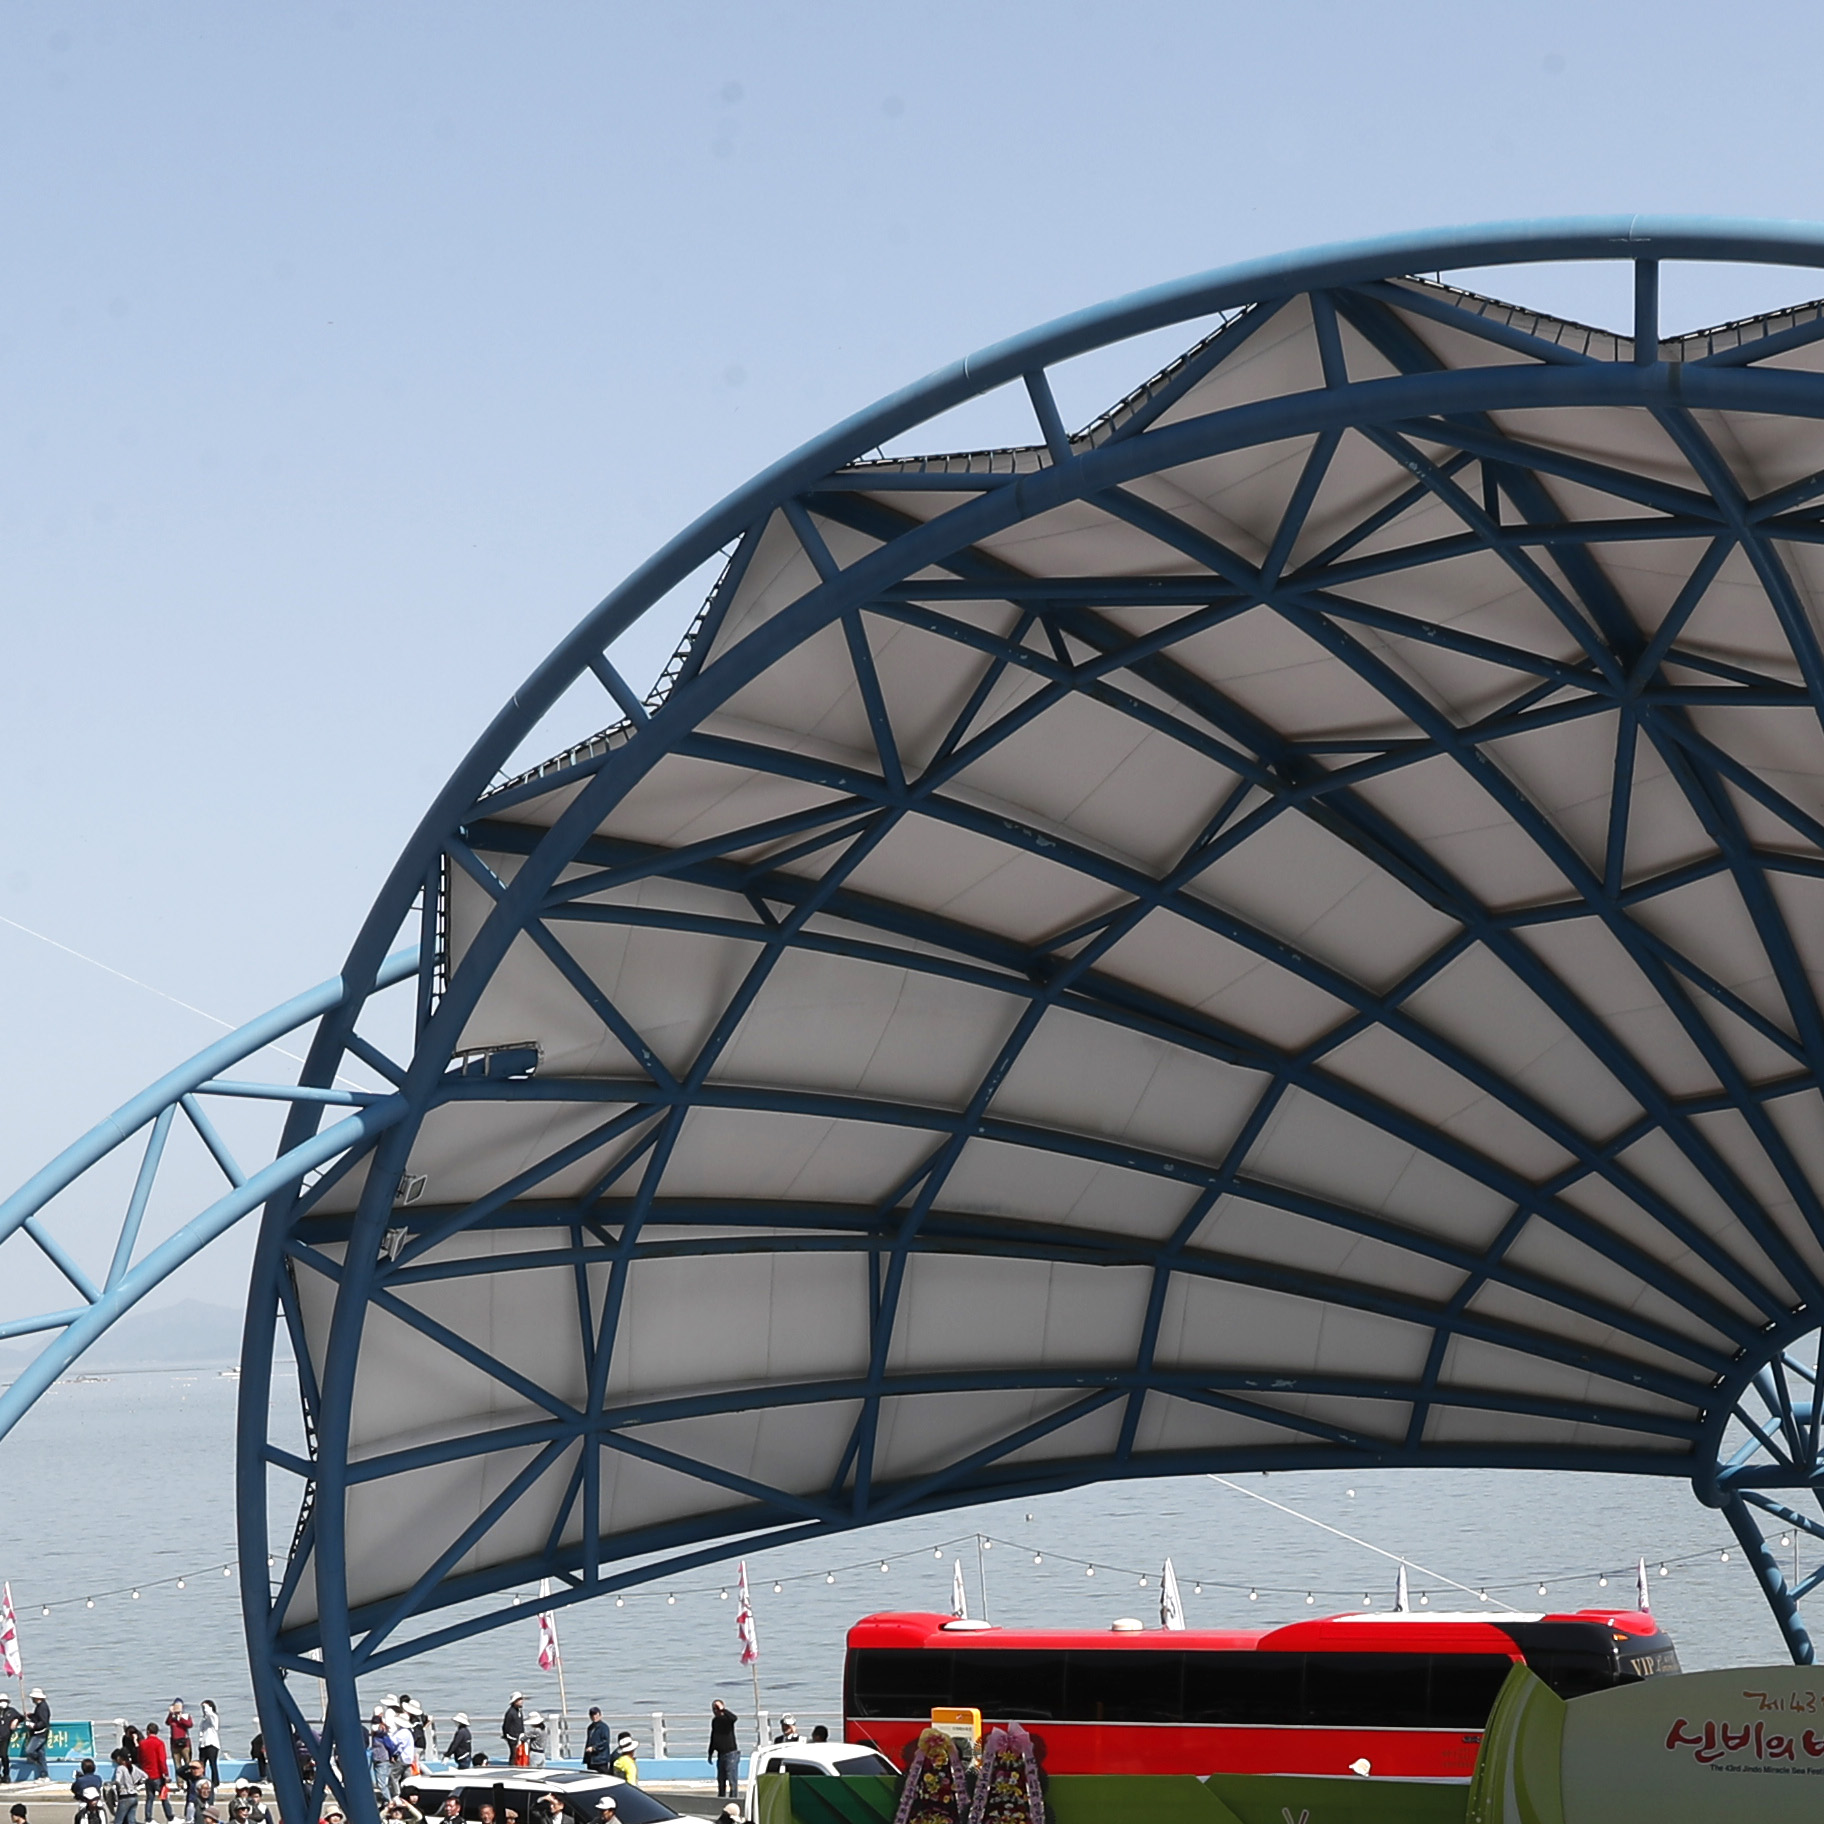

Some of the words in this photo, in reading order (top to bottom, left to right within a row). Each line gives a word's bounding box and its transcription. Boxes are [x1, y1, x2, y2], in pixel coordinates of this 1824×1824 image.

[1630, 1656, 1654, 1676] VIP
[1742, 1765, 1762, 1774] Jindo
[1763, 1766, 1790, 1775] Miracle
[1791, 1767, 1805, 1775] Sea
